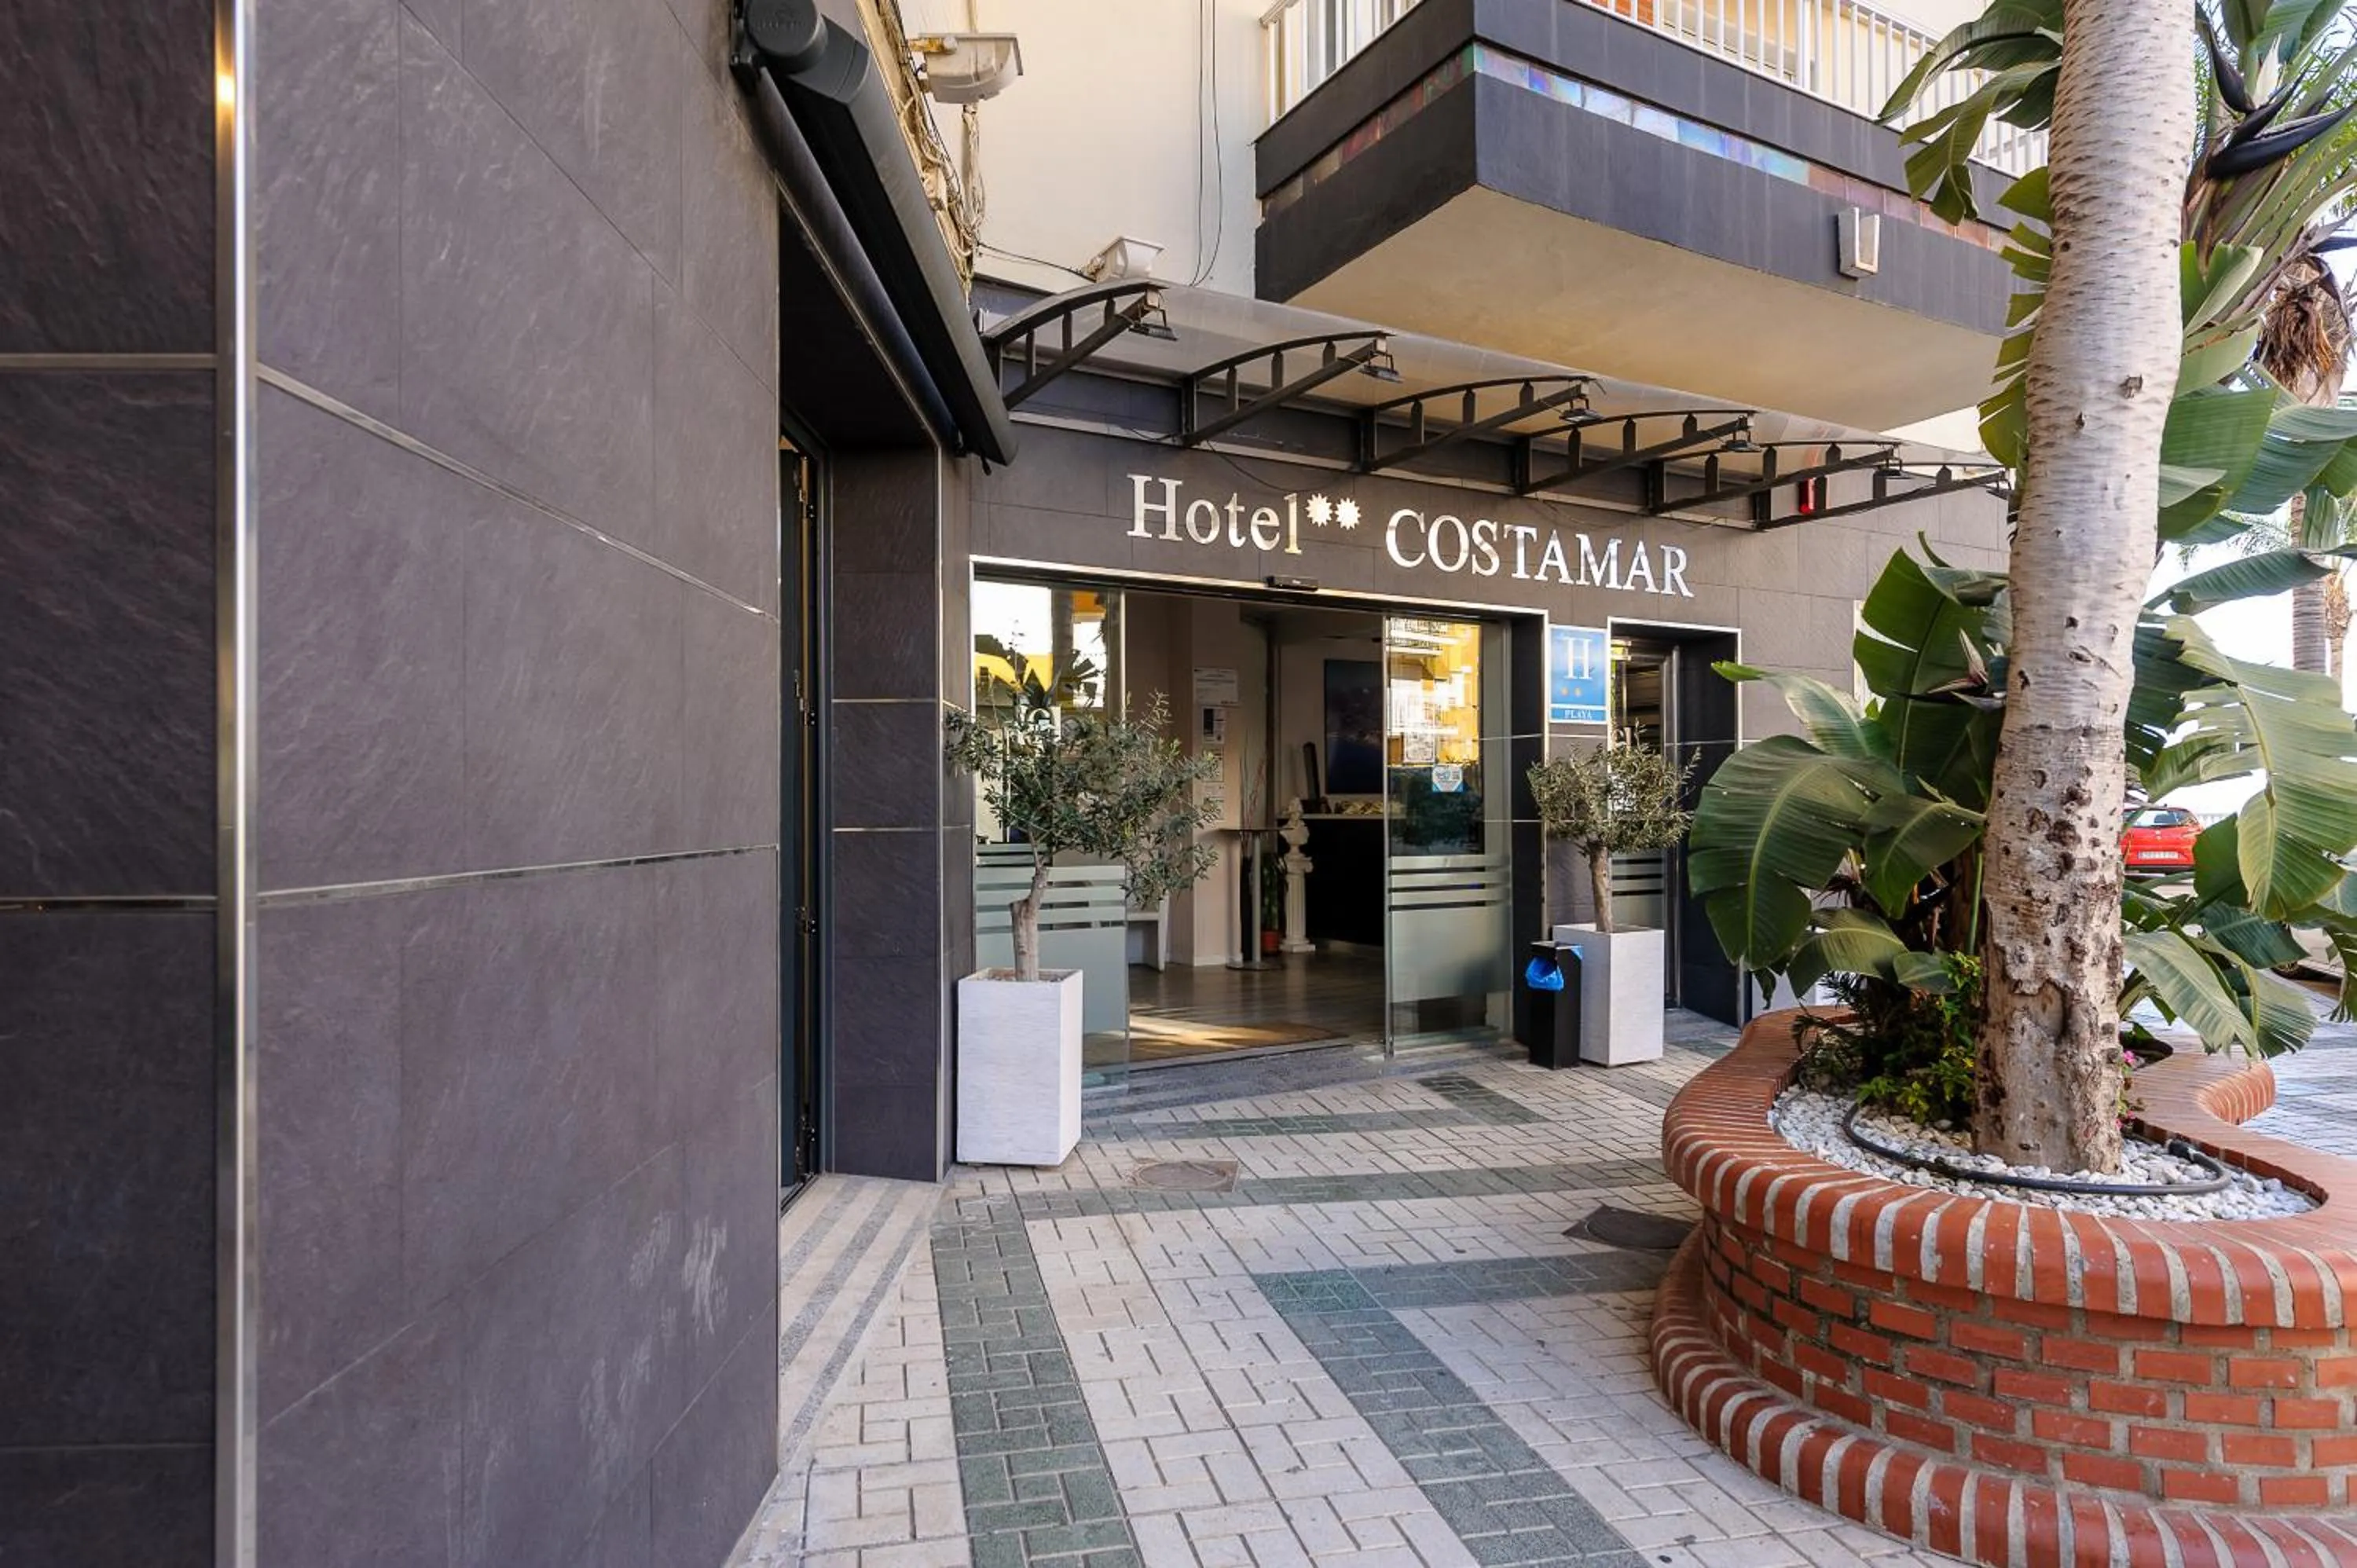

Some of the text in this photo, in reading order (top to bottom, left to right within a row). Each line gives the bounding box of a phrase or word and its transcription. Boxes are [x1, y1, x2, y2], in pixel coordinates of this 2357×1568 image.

[1127, 474, 1695, 598] Hotel COSTAMAR
[1563, 637, 1593, 680] H
[1564, 709, 1593, 720] PLAYA
